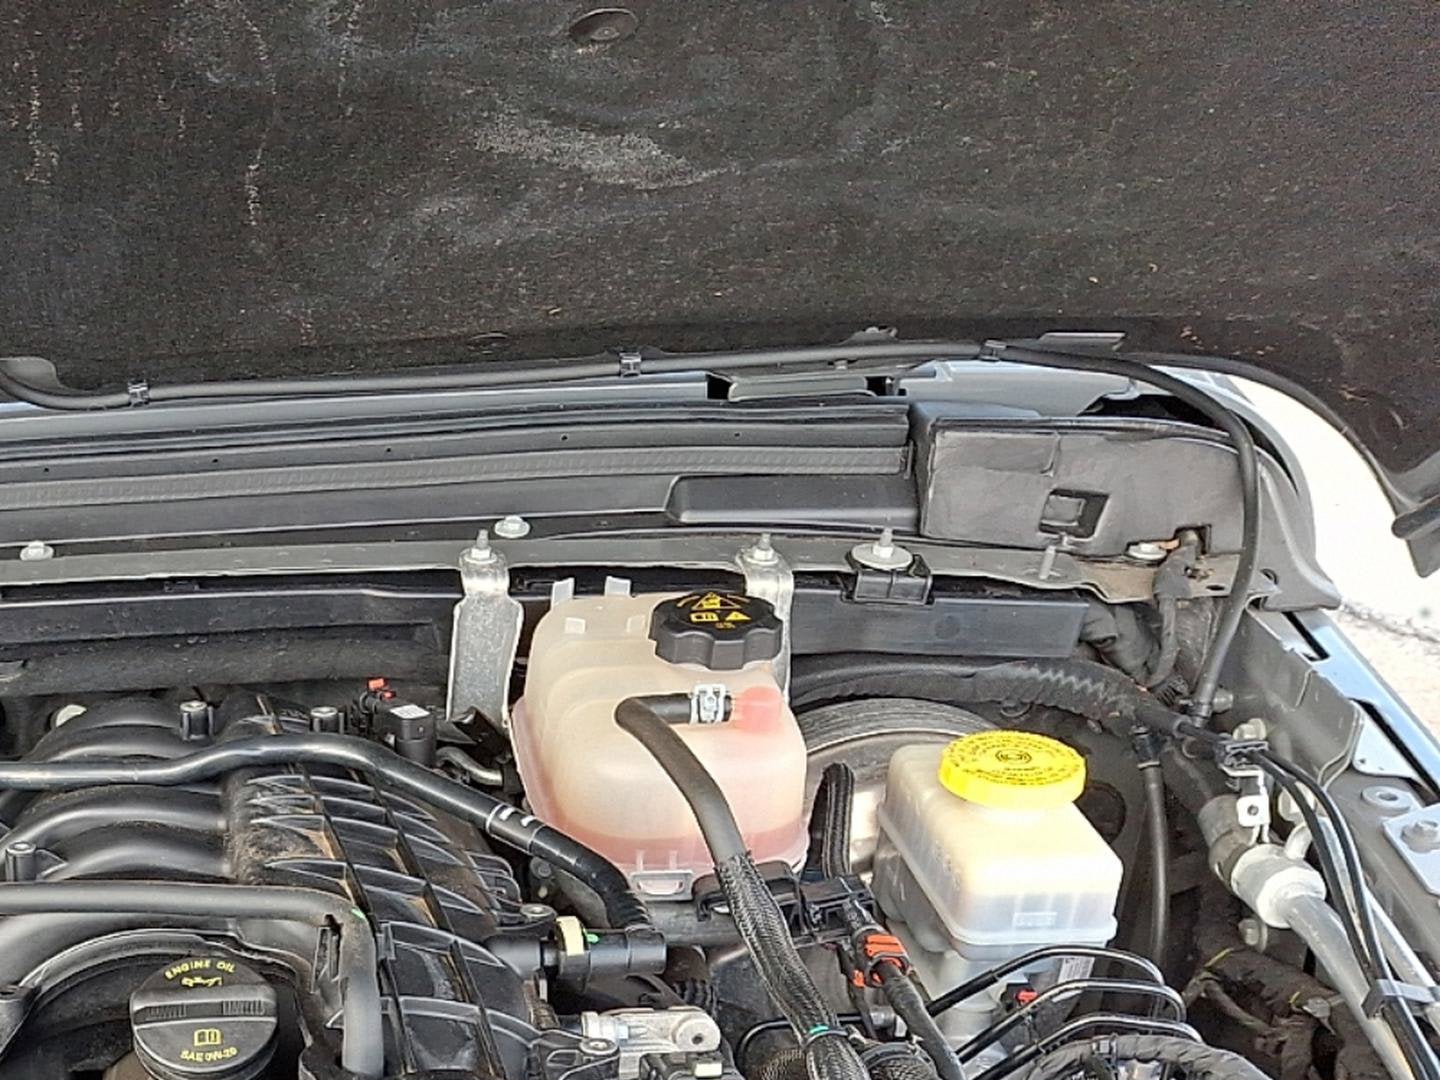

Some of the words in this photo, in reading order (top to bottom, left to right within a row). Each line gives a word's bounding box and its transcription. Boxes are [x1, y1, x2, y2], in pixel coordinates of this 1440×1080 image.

[165, 960, 211, 979] ENGINE
[216, 961, 237, 973] OIL
[180, 1049, 204, 1062] SAE
